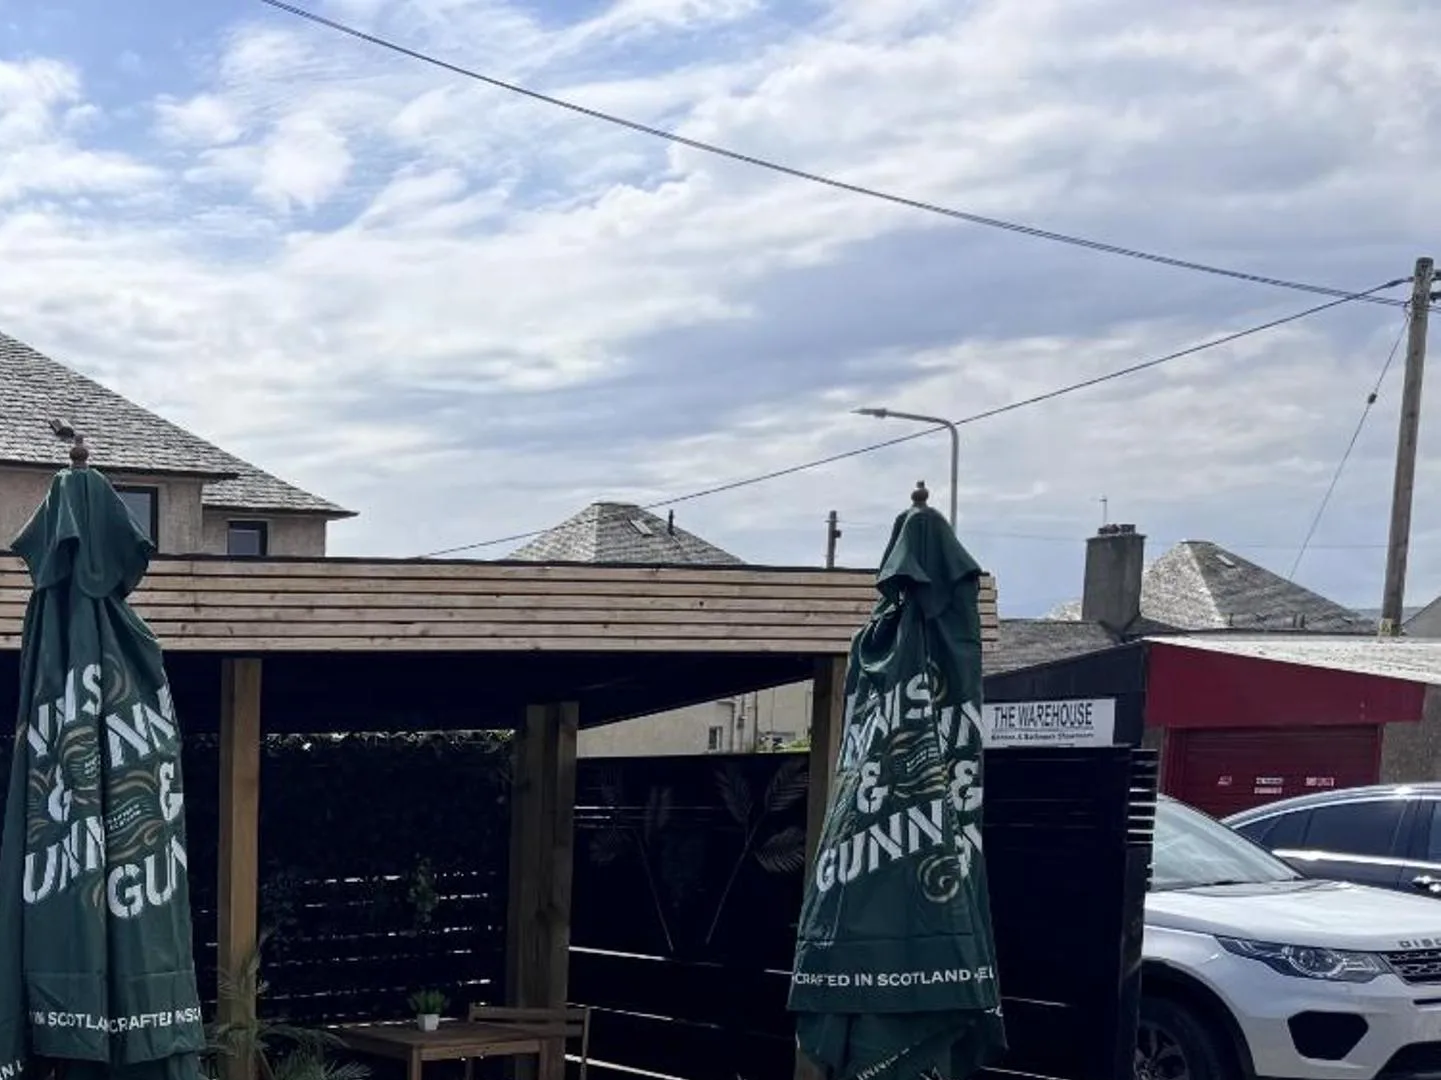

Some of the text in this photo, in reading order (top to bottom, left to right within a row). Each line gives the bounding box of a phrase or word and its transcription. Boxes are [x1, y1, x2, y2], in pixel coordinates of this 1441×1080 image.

[994, 703, 1093, 728] THE WAREHOUSE
[816, 799, 943, 892] GUNN
[854, 973, 873, 987] IN
[876, 969, 971, 987] SCOTLAND
